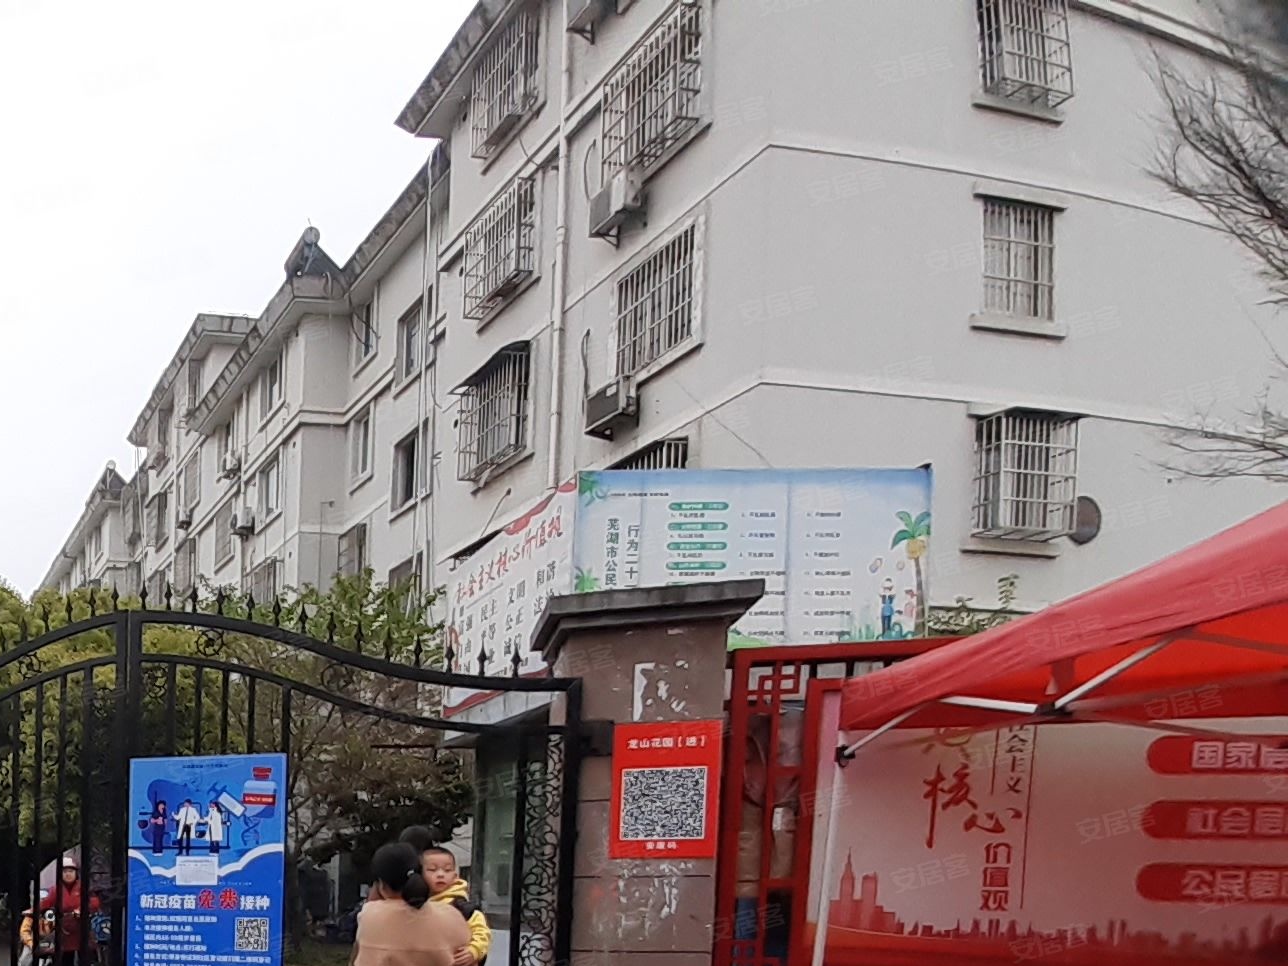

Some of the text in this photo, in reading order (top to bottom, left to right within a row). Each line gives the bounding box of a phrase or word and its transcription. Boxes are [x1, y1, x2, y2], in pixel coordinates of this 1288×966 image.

[922, 762, 1024, 850] 核心
[1185, 806, 1288, 835] 社会层
[979, 841, 1014, 912] 价值观
